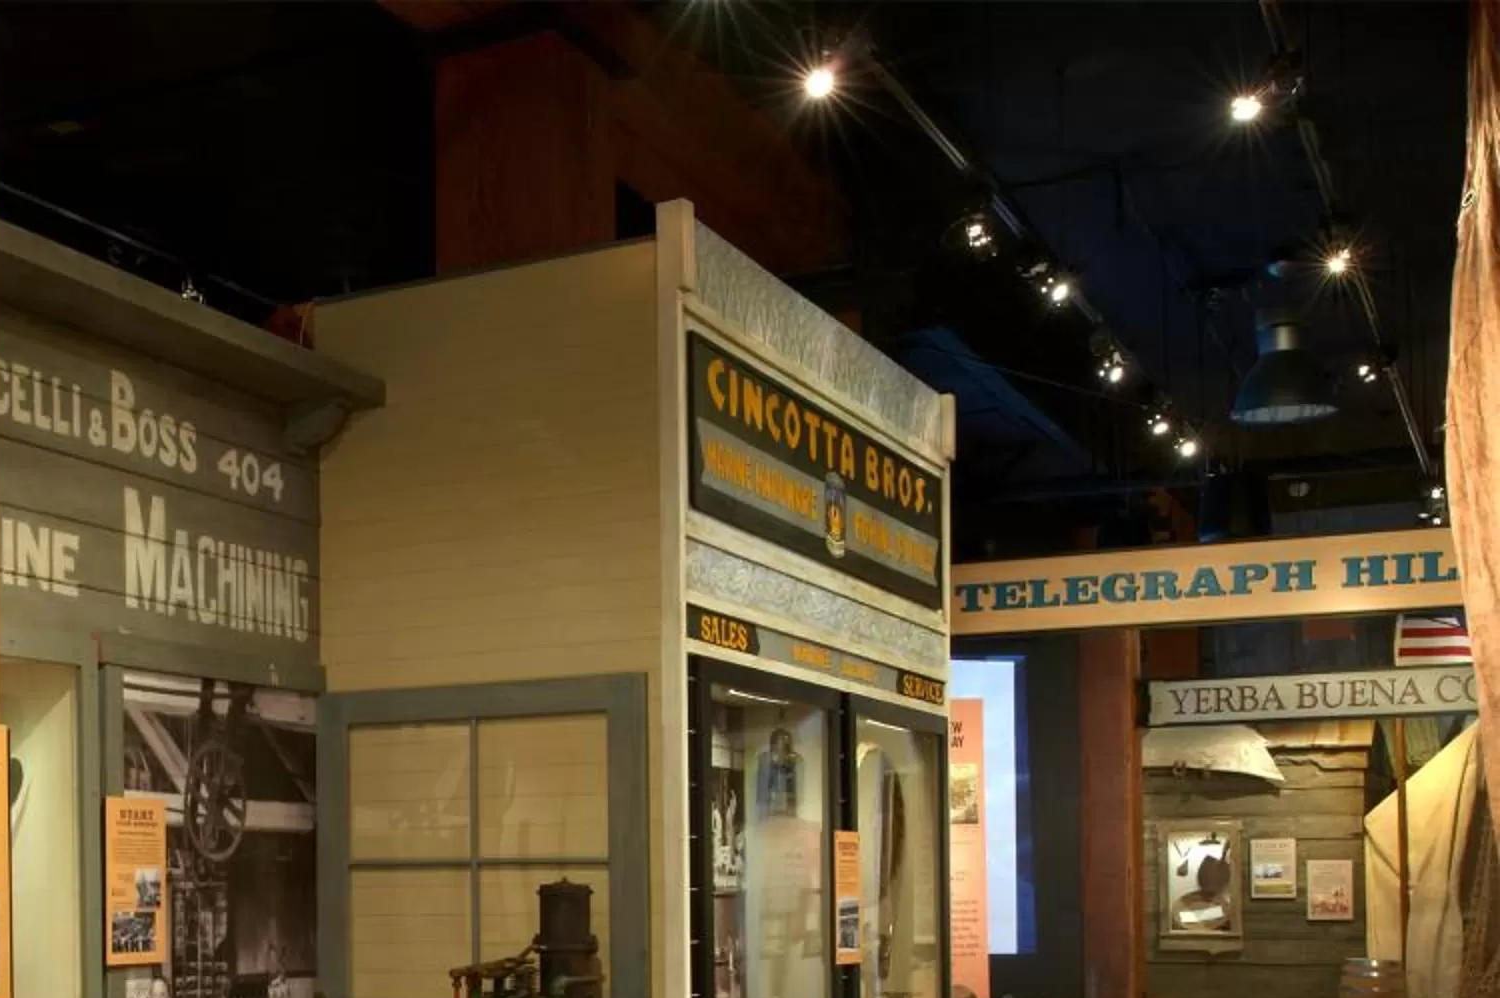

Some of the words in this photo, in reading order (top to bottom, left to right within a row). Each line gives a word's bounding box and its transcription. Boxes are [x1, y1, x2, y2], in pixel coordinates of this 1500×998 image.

[87, 408, 107, 447] &
[110, 369, 198, 475] BOSS
[217, 449, 284, 502] 404
[707, 355, 856, 481] CINCOTTA
[865, 445, 933, 514] BROS.
[124, 487, 310, 643] MACHINING
[955, 559, 1317, 613] TELEGRAPH
[701, 614, 749, 651] SALES
[902, 672, 943, 706] SERVICE
[1170, 683, 1287, 716] YERBA
[1296, 675, 1424, 709] BUENA
